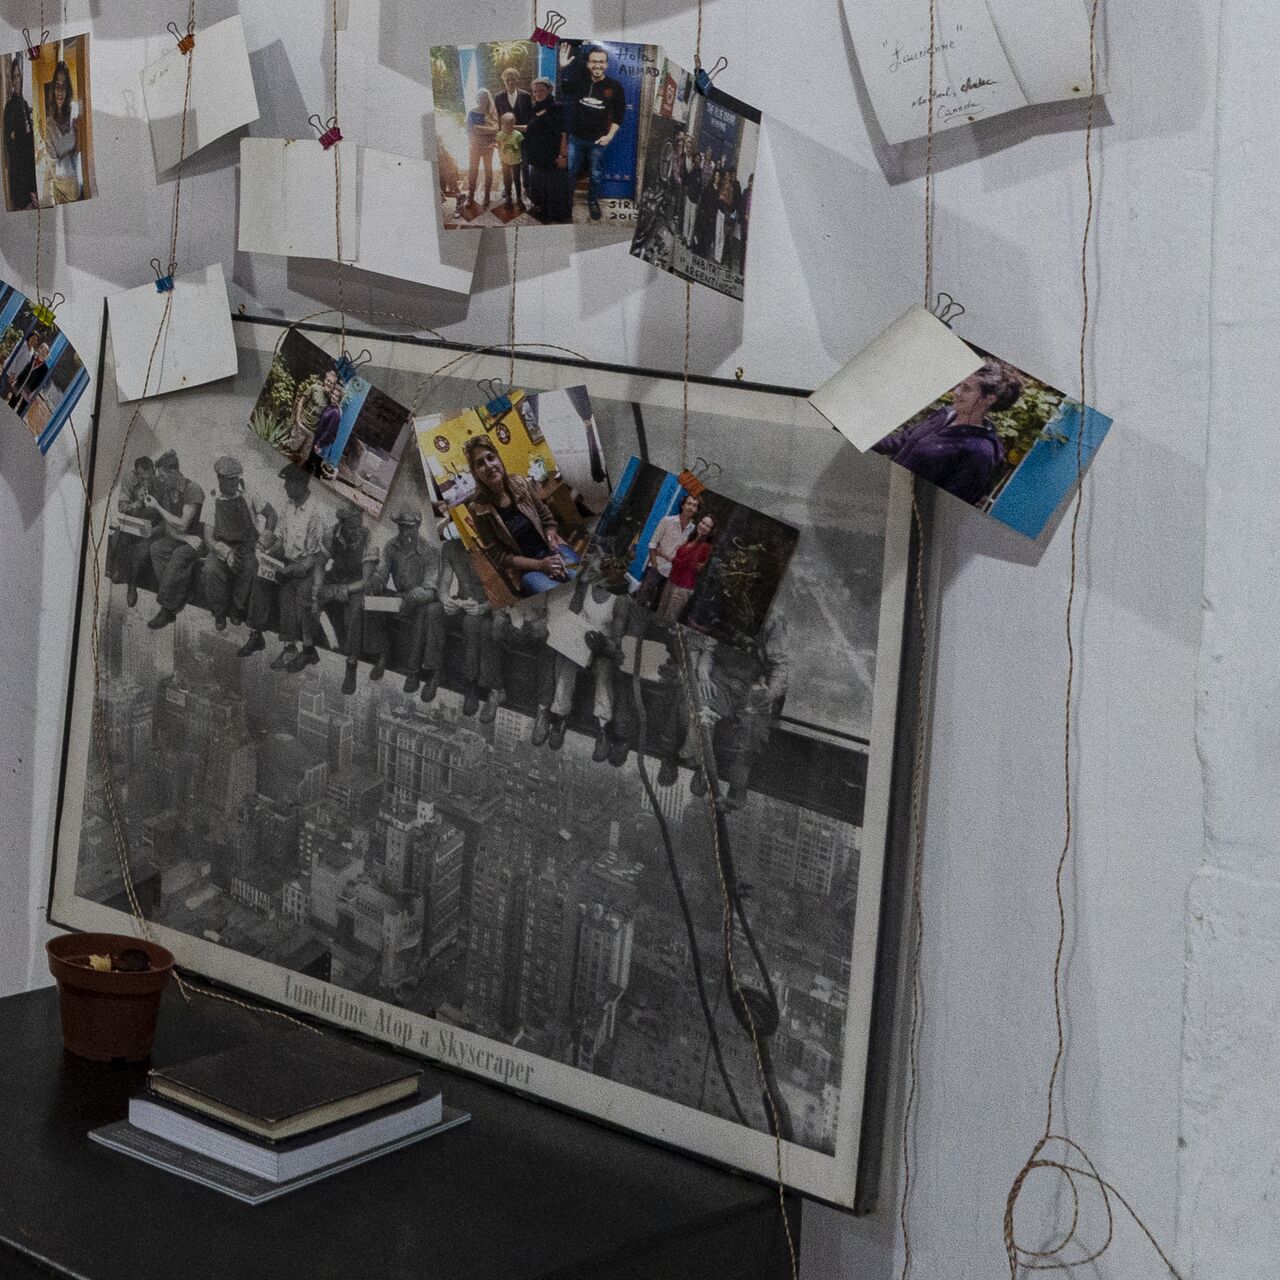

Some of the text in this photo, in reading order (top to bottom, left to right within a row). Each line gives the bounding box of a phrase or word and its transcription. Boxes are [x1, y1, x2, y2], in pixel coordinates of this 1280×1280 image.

[375, 1008, 413, 1047] Atop
[419, 1028, 429, 1046] a
[439, 1028, 534, 1085] Skyscraper
